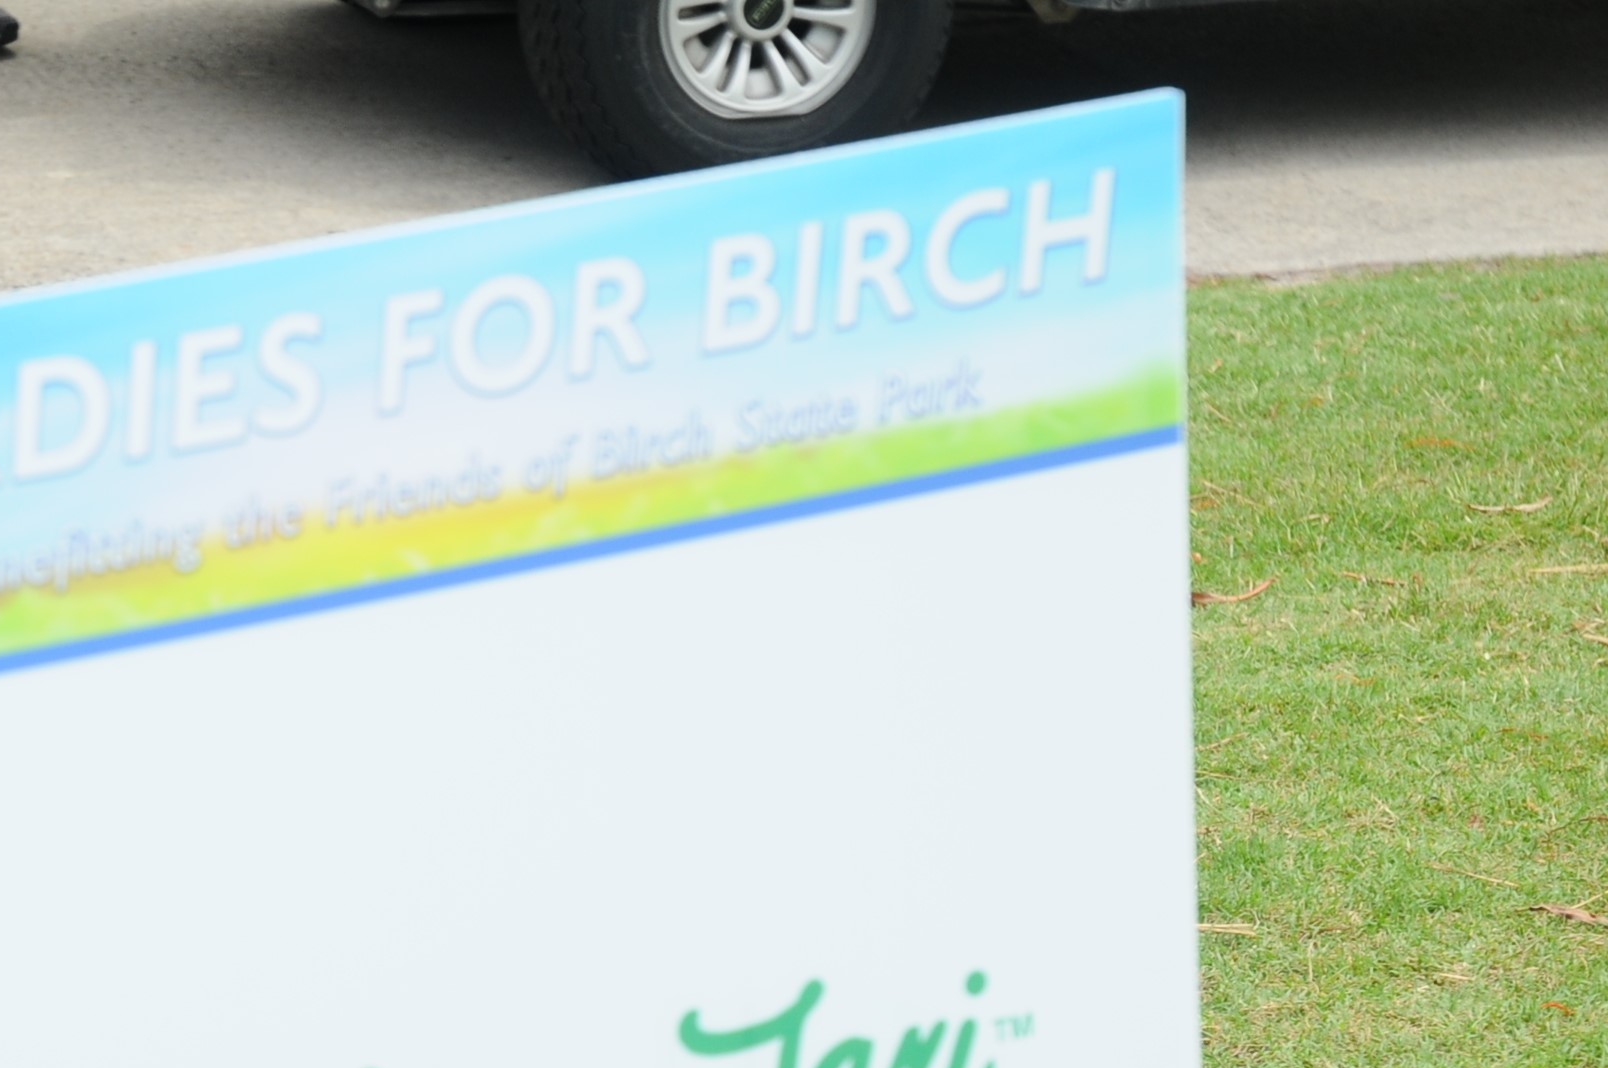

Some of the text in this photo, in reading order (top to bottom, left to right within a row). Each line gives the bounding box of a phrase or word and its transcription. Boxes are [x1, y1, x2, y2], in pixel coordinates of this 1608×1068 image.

[377, 256, 650, 416] FOR
[701, 166, 1116, 355] BIRCH
[225, 488, 304, 550] the
[325, 450, 503, 531] Friends
[525, 432, 580, 502] of
[593, 410, 713, 482] Birch
[736, 391, 858, 453] State
[877, 357, 984, 425] Park
